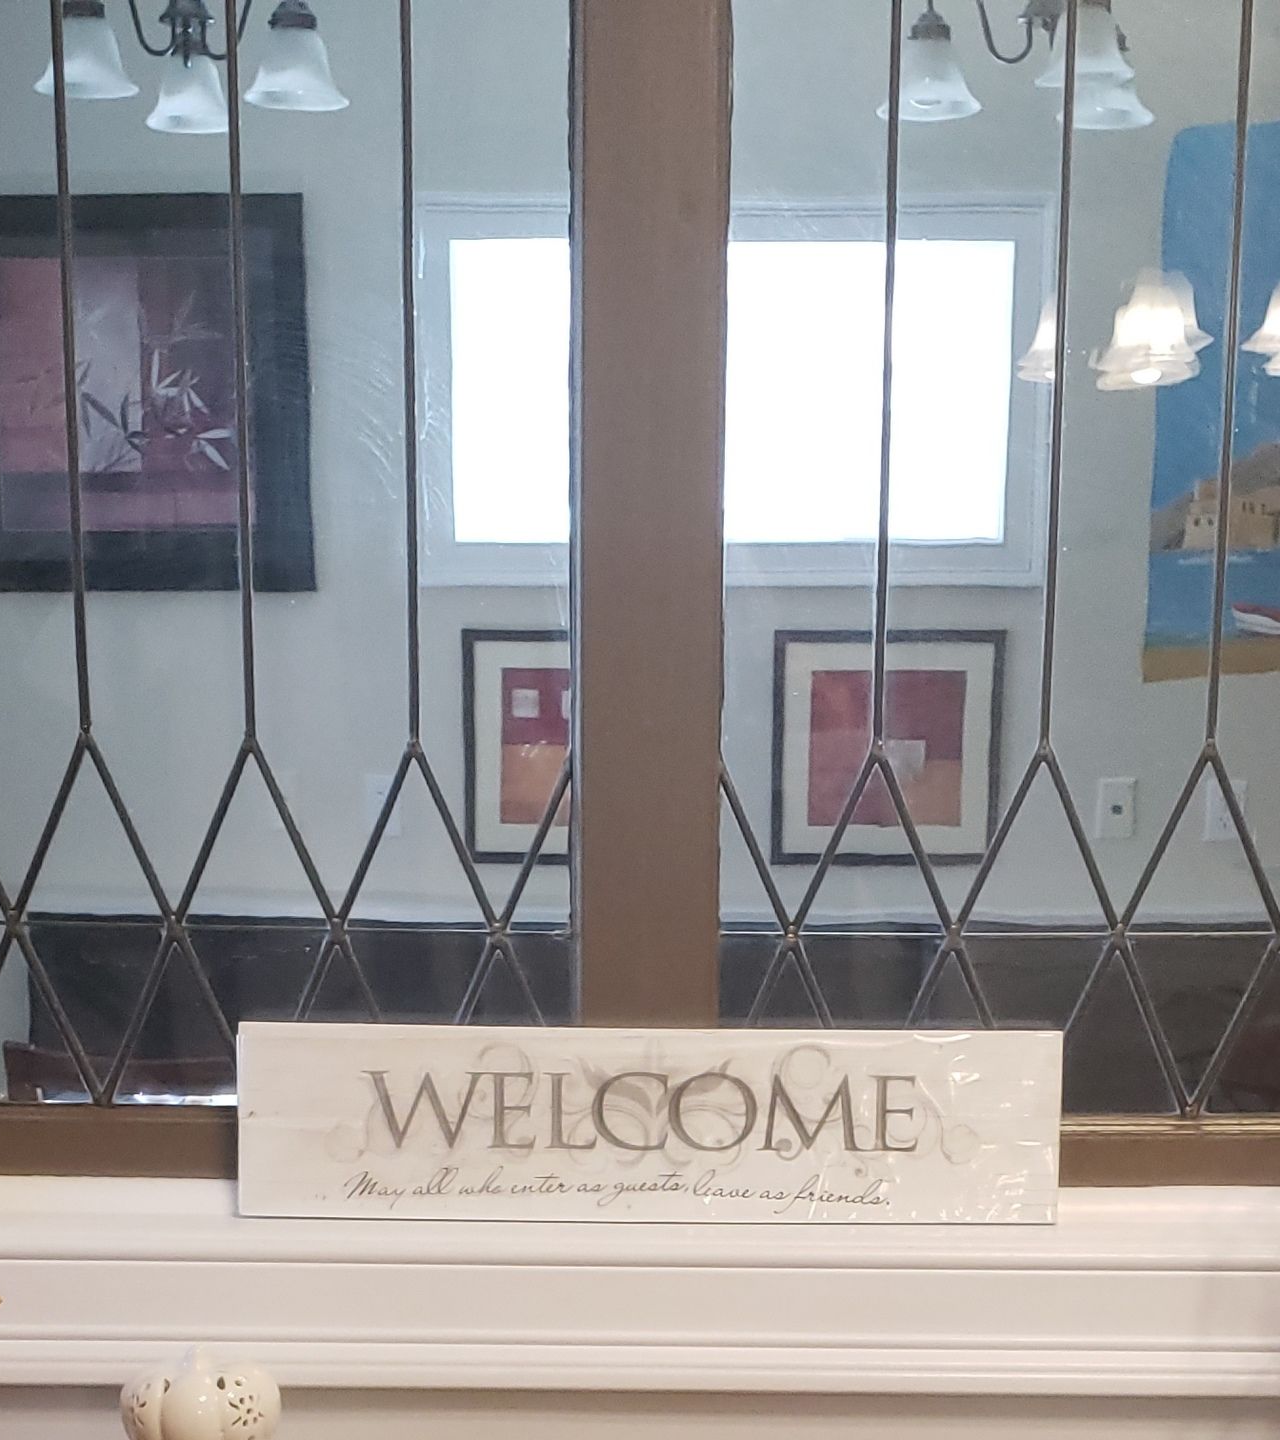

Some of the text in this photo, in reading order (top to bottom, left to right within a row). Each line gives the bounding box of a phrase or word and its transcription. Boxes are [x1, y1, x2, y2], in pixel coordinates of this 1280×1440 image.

[360, 1069, 919, 1152] WELCOME
[344, 1166, 891, 1214] May all who enter as guests, leave as friends.
